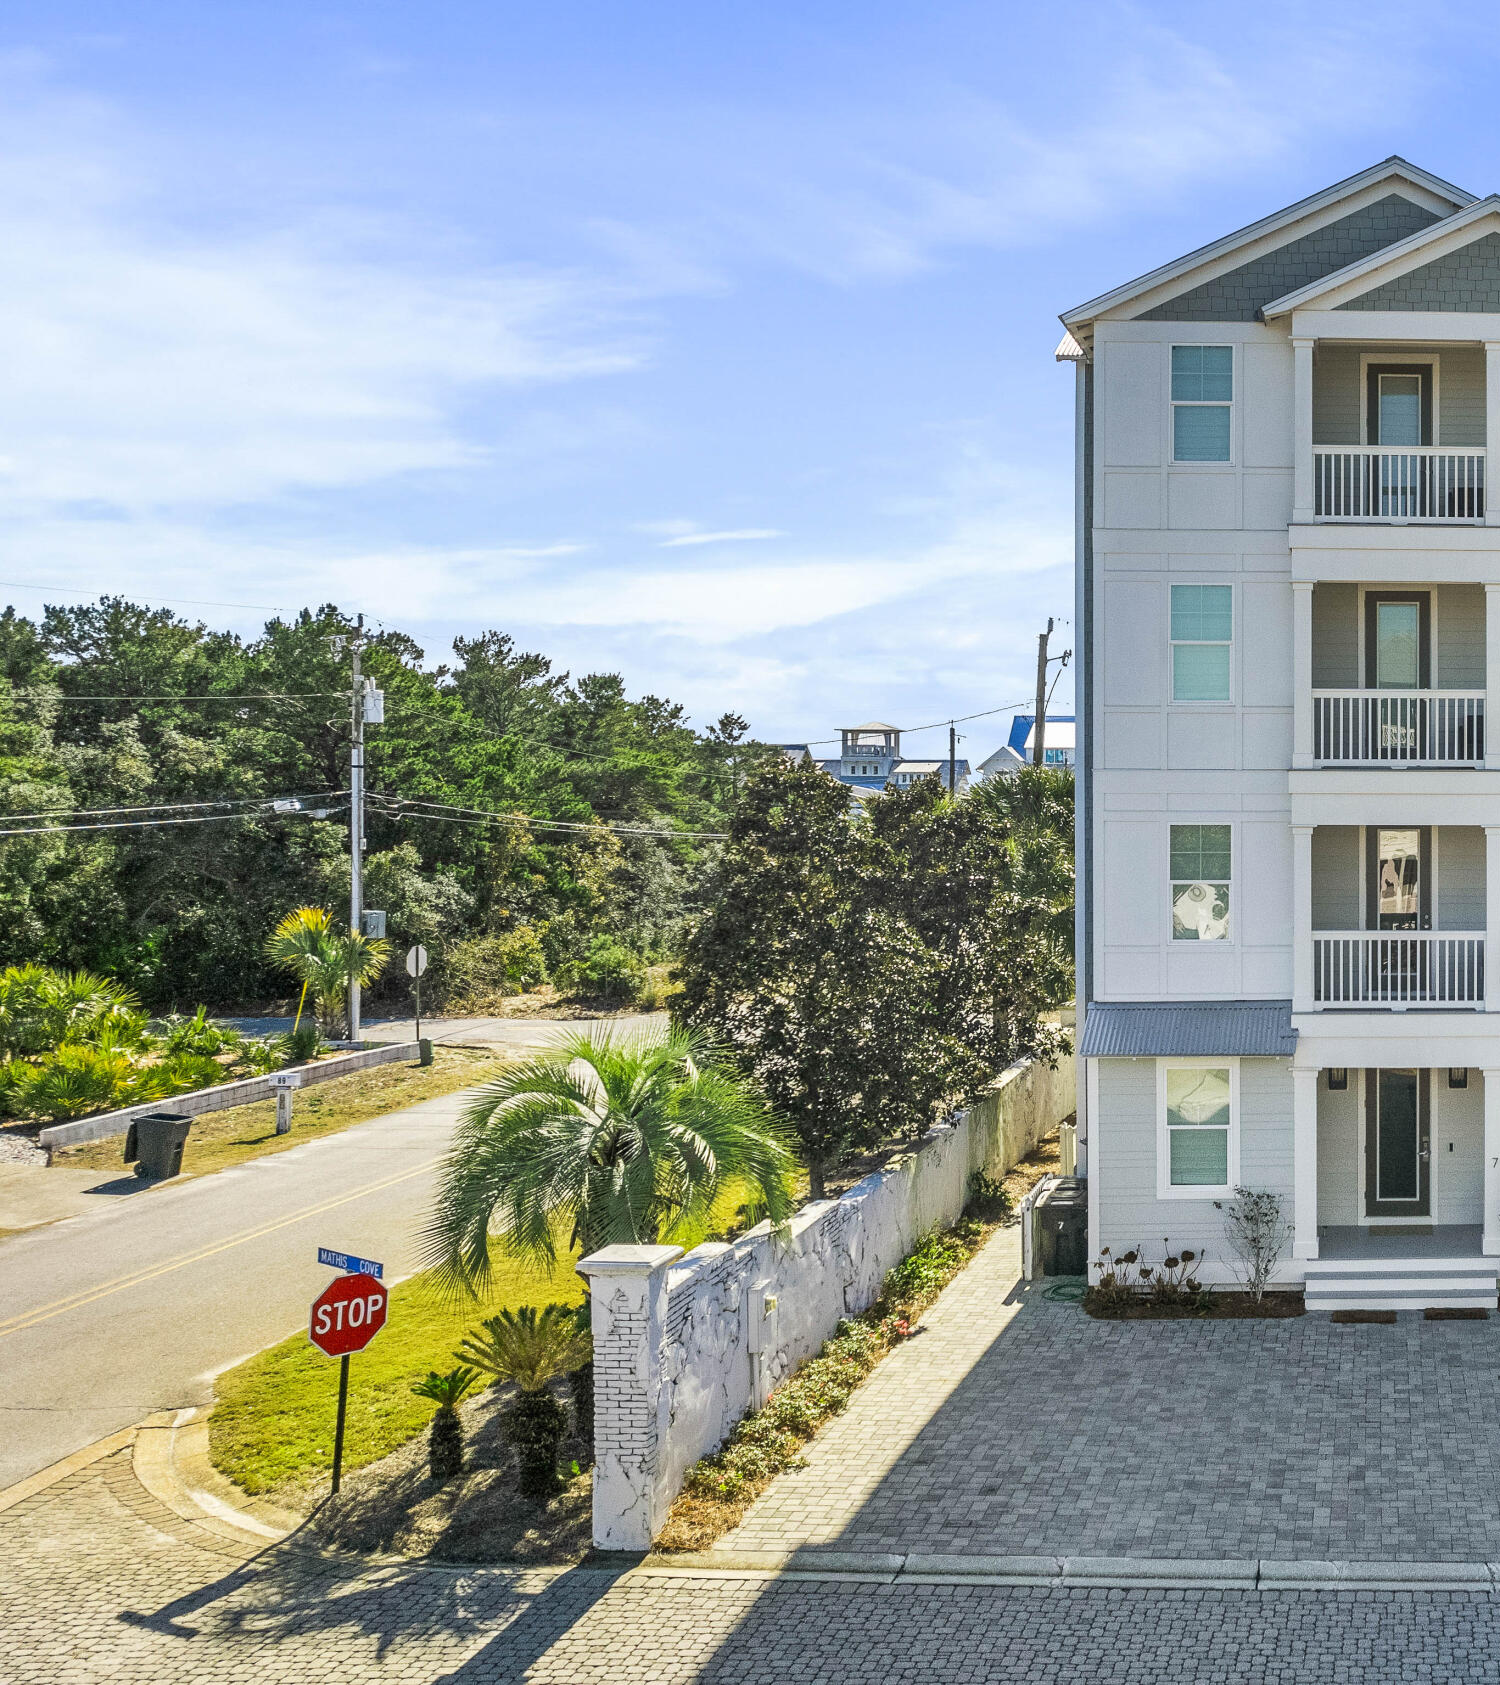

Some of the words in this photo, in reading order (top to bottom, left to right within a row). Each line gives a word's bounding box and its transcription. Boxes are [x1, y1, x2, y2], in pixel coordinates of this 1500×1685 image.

[1492, 1157, 1498, 1168] 7
[321, 1249, 348, 1268] MATHIS
[360, 1260, 380, 1276] COVE
[315, 1294, 383, 1335] STOP
